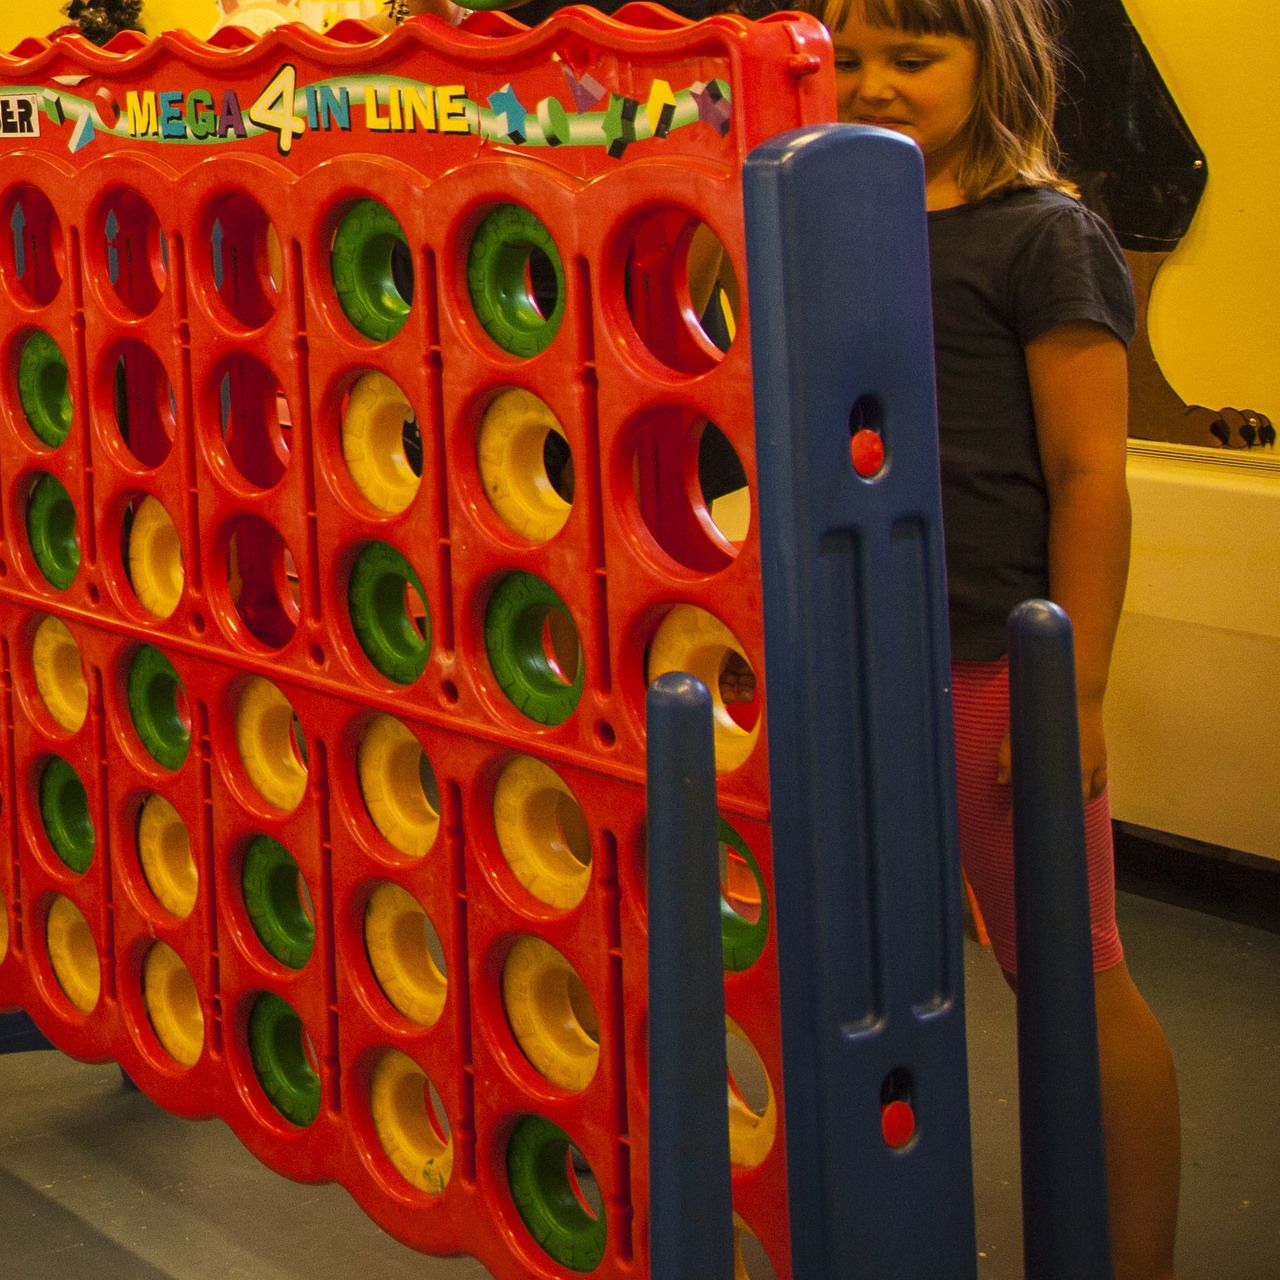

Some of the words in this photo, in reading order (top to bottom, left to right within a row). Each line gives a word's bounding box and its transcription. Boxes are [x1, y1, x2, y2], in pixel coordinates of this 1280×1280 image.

[125, 88, 247, 138] MEGA
[248, 63, 307, 156] 4
[305, 86, 351, 131] IN
[364, 85, 471, 133] LINE
